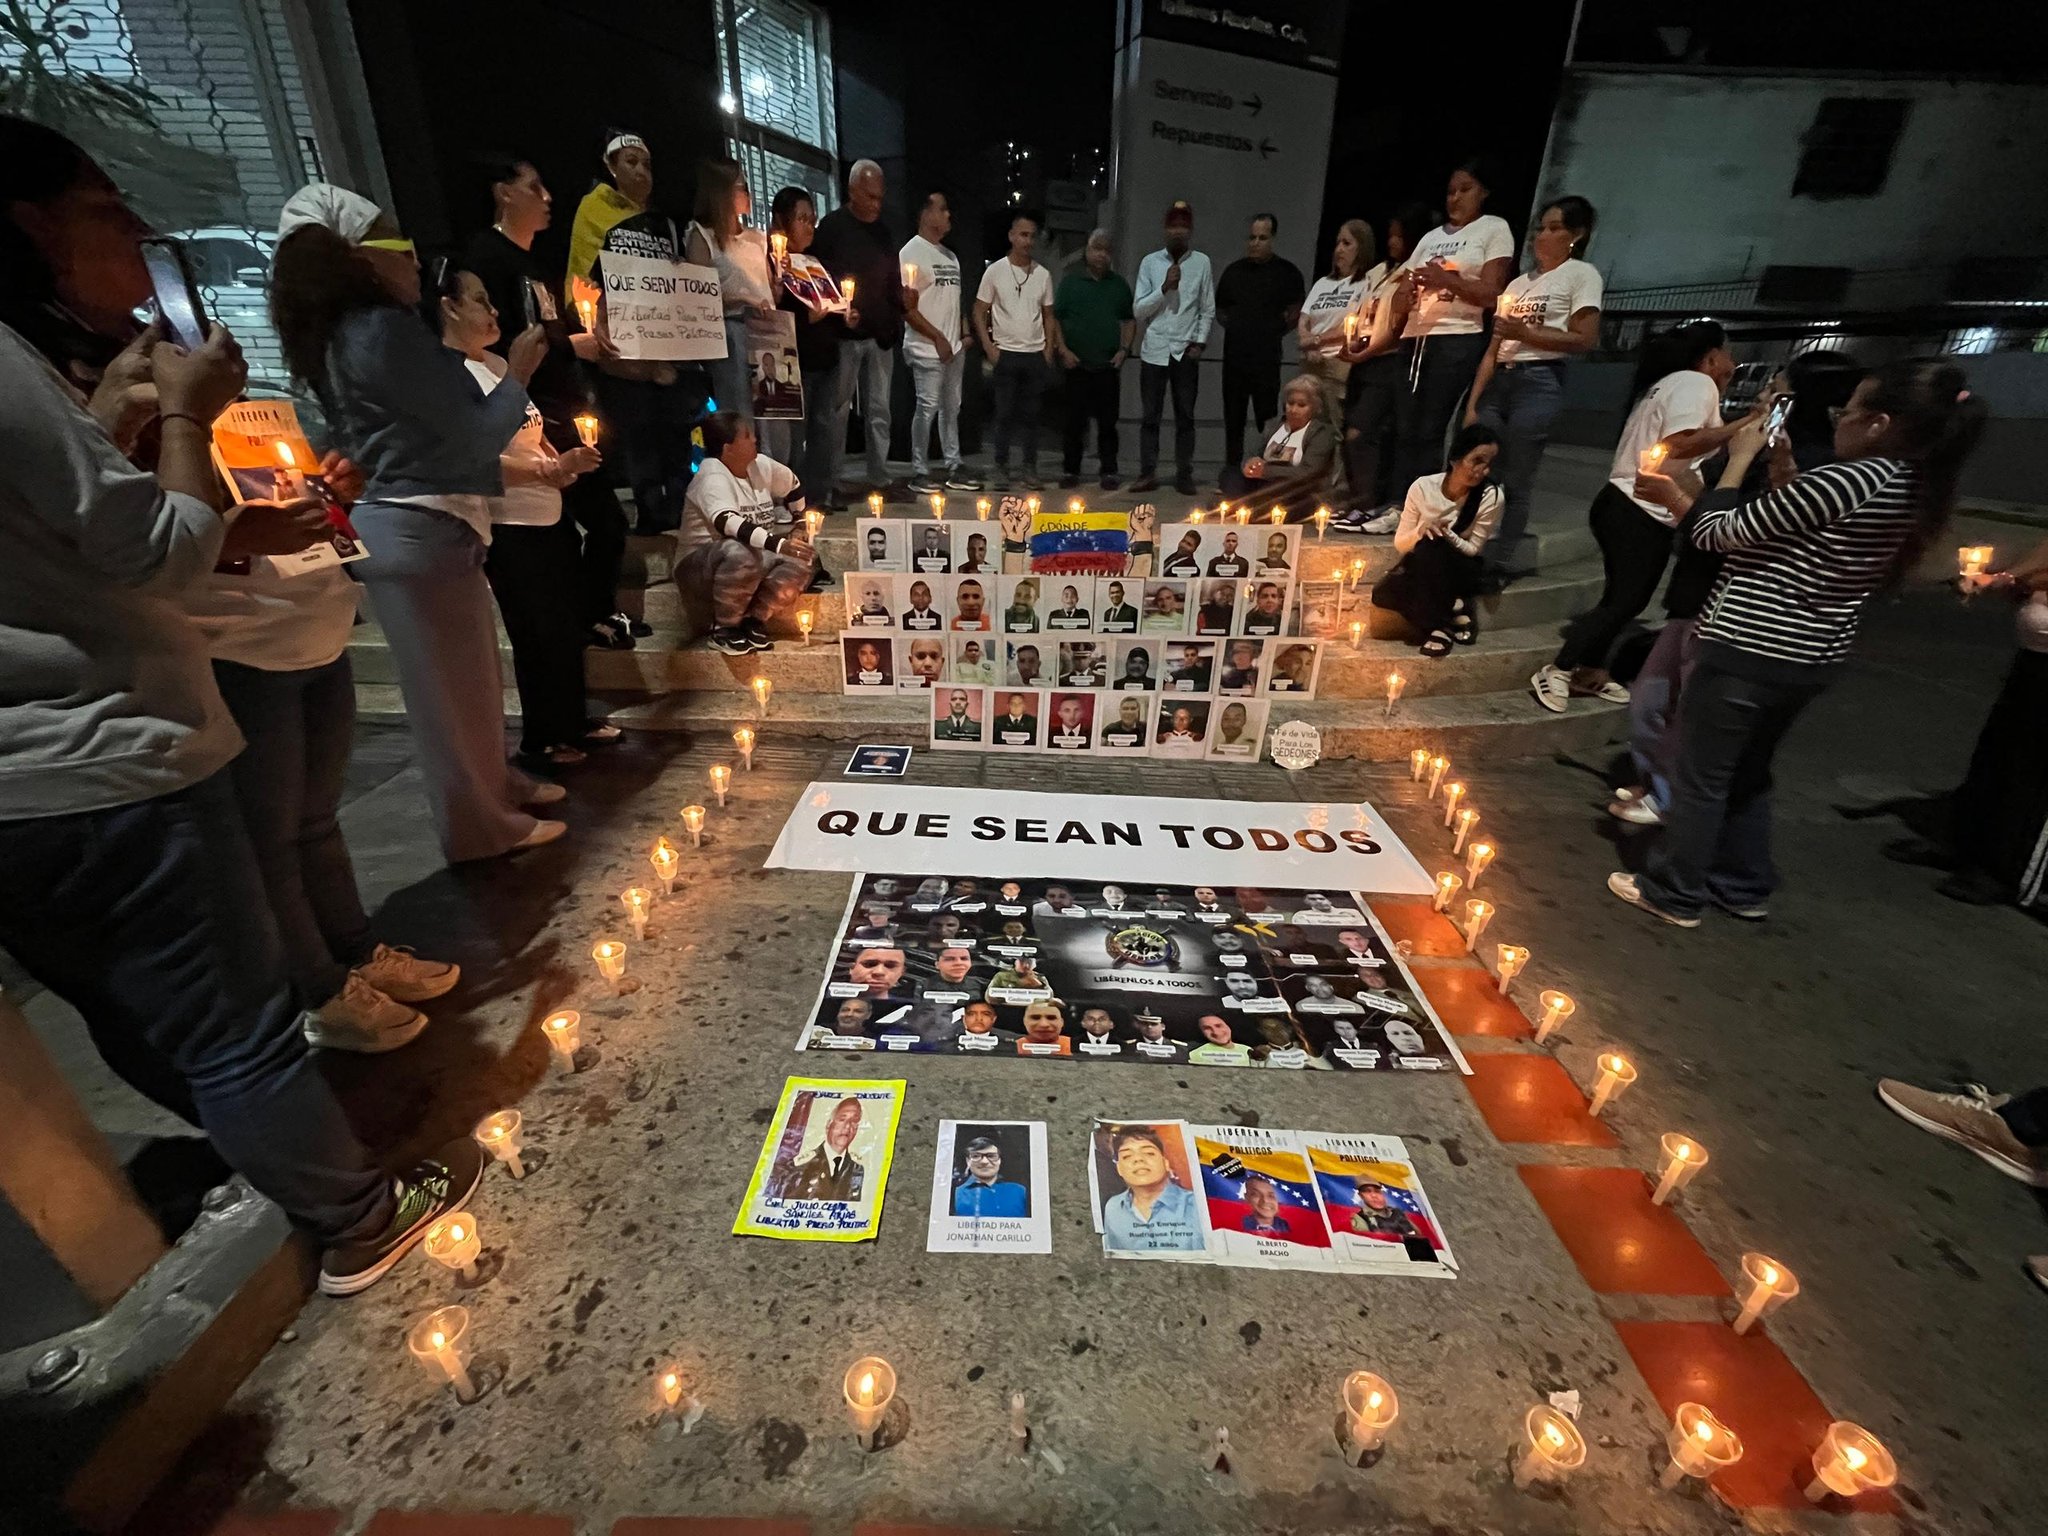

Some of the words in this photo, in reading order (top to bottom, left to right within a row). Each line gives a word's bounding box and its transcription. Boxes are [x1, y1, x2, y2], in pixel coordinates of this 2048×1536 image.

[609, 238, 661, 251] CENTROS
[604, 269, 635, 292] ¡QUE
[641, 276, 676, 294] SEAN
[678, 278, 718, 296] TODOS
[612, 328, 634, 340] Los
[1280, 739, 1298, 747] Para
[1273, 747, 1318, 759] GEDEONES
[817, 810, 950, 837] QUE
[971, 816, 1142, 846] SEAN
[1160, 825, 1382, 854] TODOS
[1094, 975, 1154, 985] LIBÉRENLOS
[1166, 980, 1204, 989] TODOS
[1217, 1128, 1259, 1137] LIBEREN
[1325, 1139, 1365, 1148] LIBEREN
[1229, 1146, 1273, 1155] POLITICOS
[957, 1221, 998, 1229] LIBERTAD
[1000, 1222, 1022, 1230] PARA
[946, 1232, 994, 1241] JONATHAN
[996, 1233, 1032, 1242] CARILLO
[1256, 1240, 1288, 1248] ALBERTO
[1259, 1249, 1289, 1257] BRACHO
